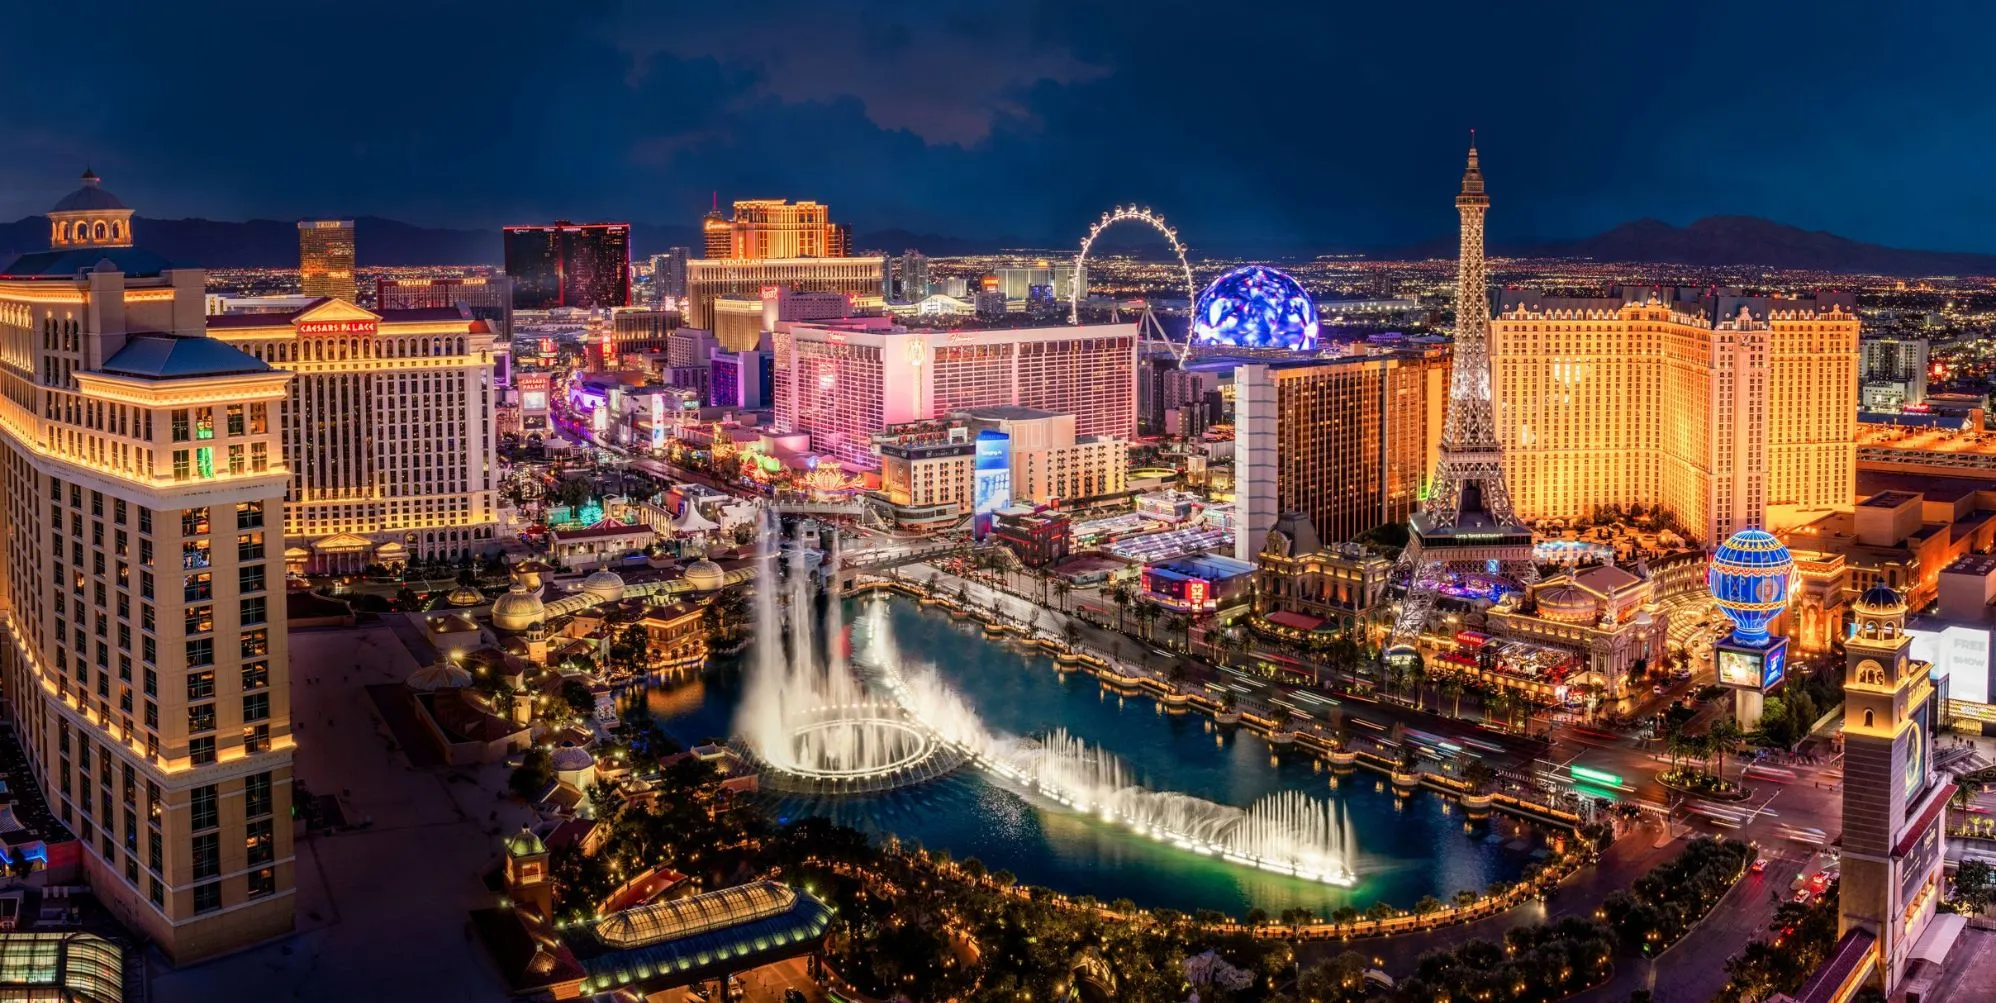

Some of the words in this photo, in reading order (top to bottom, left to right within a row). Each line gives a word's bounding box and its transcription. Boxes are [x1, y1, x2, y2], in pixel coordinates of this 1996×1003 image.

[300, 324, 339, 333] CAESARS
[341, 323, 375, 331] PALACE
[1953, 639, 1986, 652] FREE
[1953, 656, 1985, 667] SHOW
